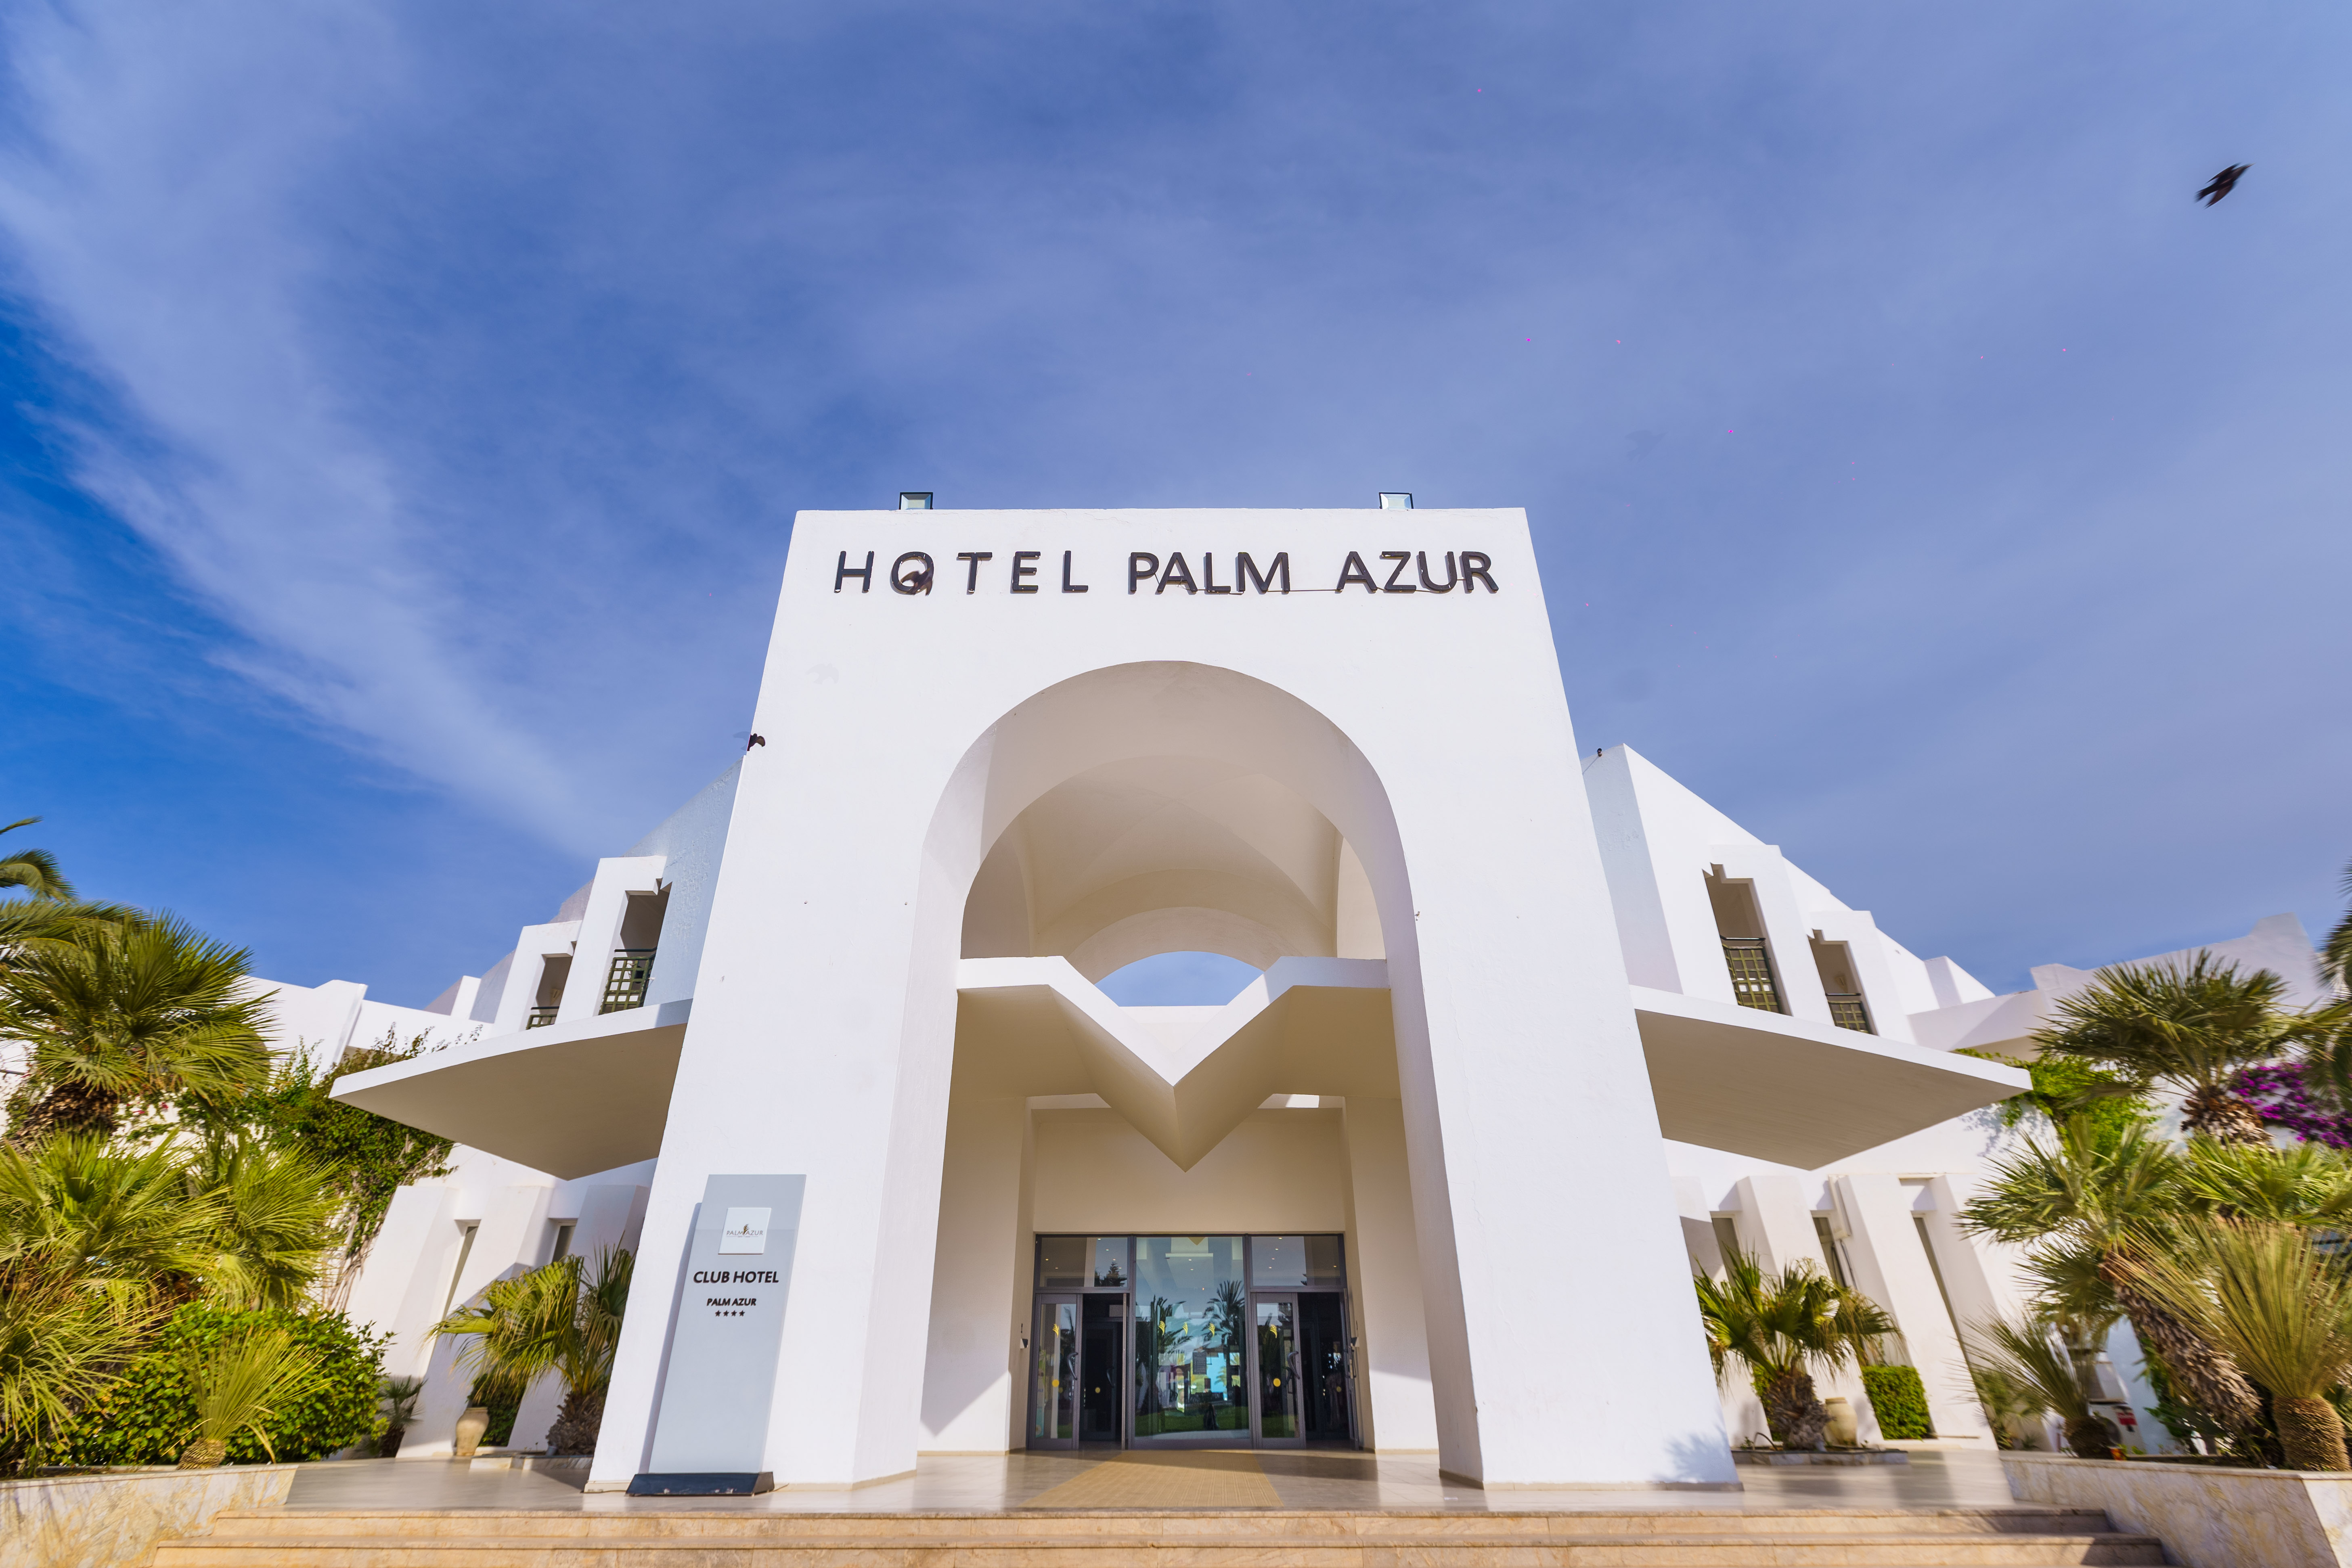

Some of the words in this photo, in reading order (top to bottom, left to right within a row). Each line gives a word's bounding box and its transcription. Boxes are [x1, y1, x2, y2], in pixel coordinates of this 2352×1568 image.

[834, 550, 1089, 594] HOTEL
[1129, 551, 1290, 594] PALM
[1336, 551, 1499, 594] AZUR
[693, 1271, 730, 1283] CLUB
[733, 1271, 779, 1283] HOTEL
[706, 1298, 731, 1306] PALM
[731, 1298, 756, 1306] AZUR
